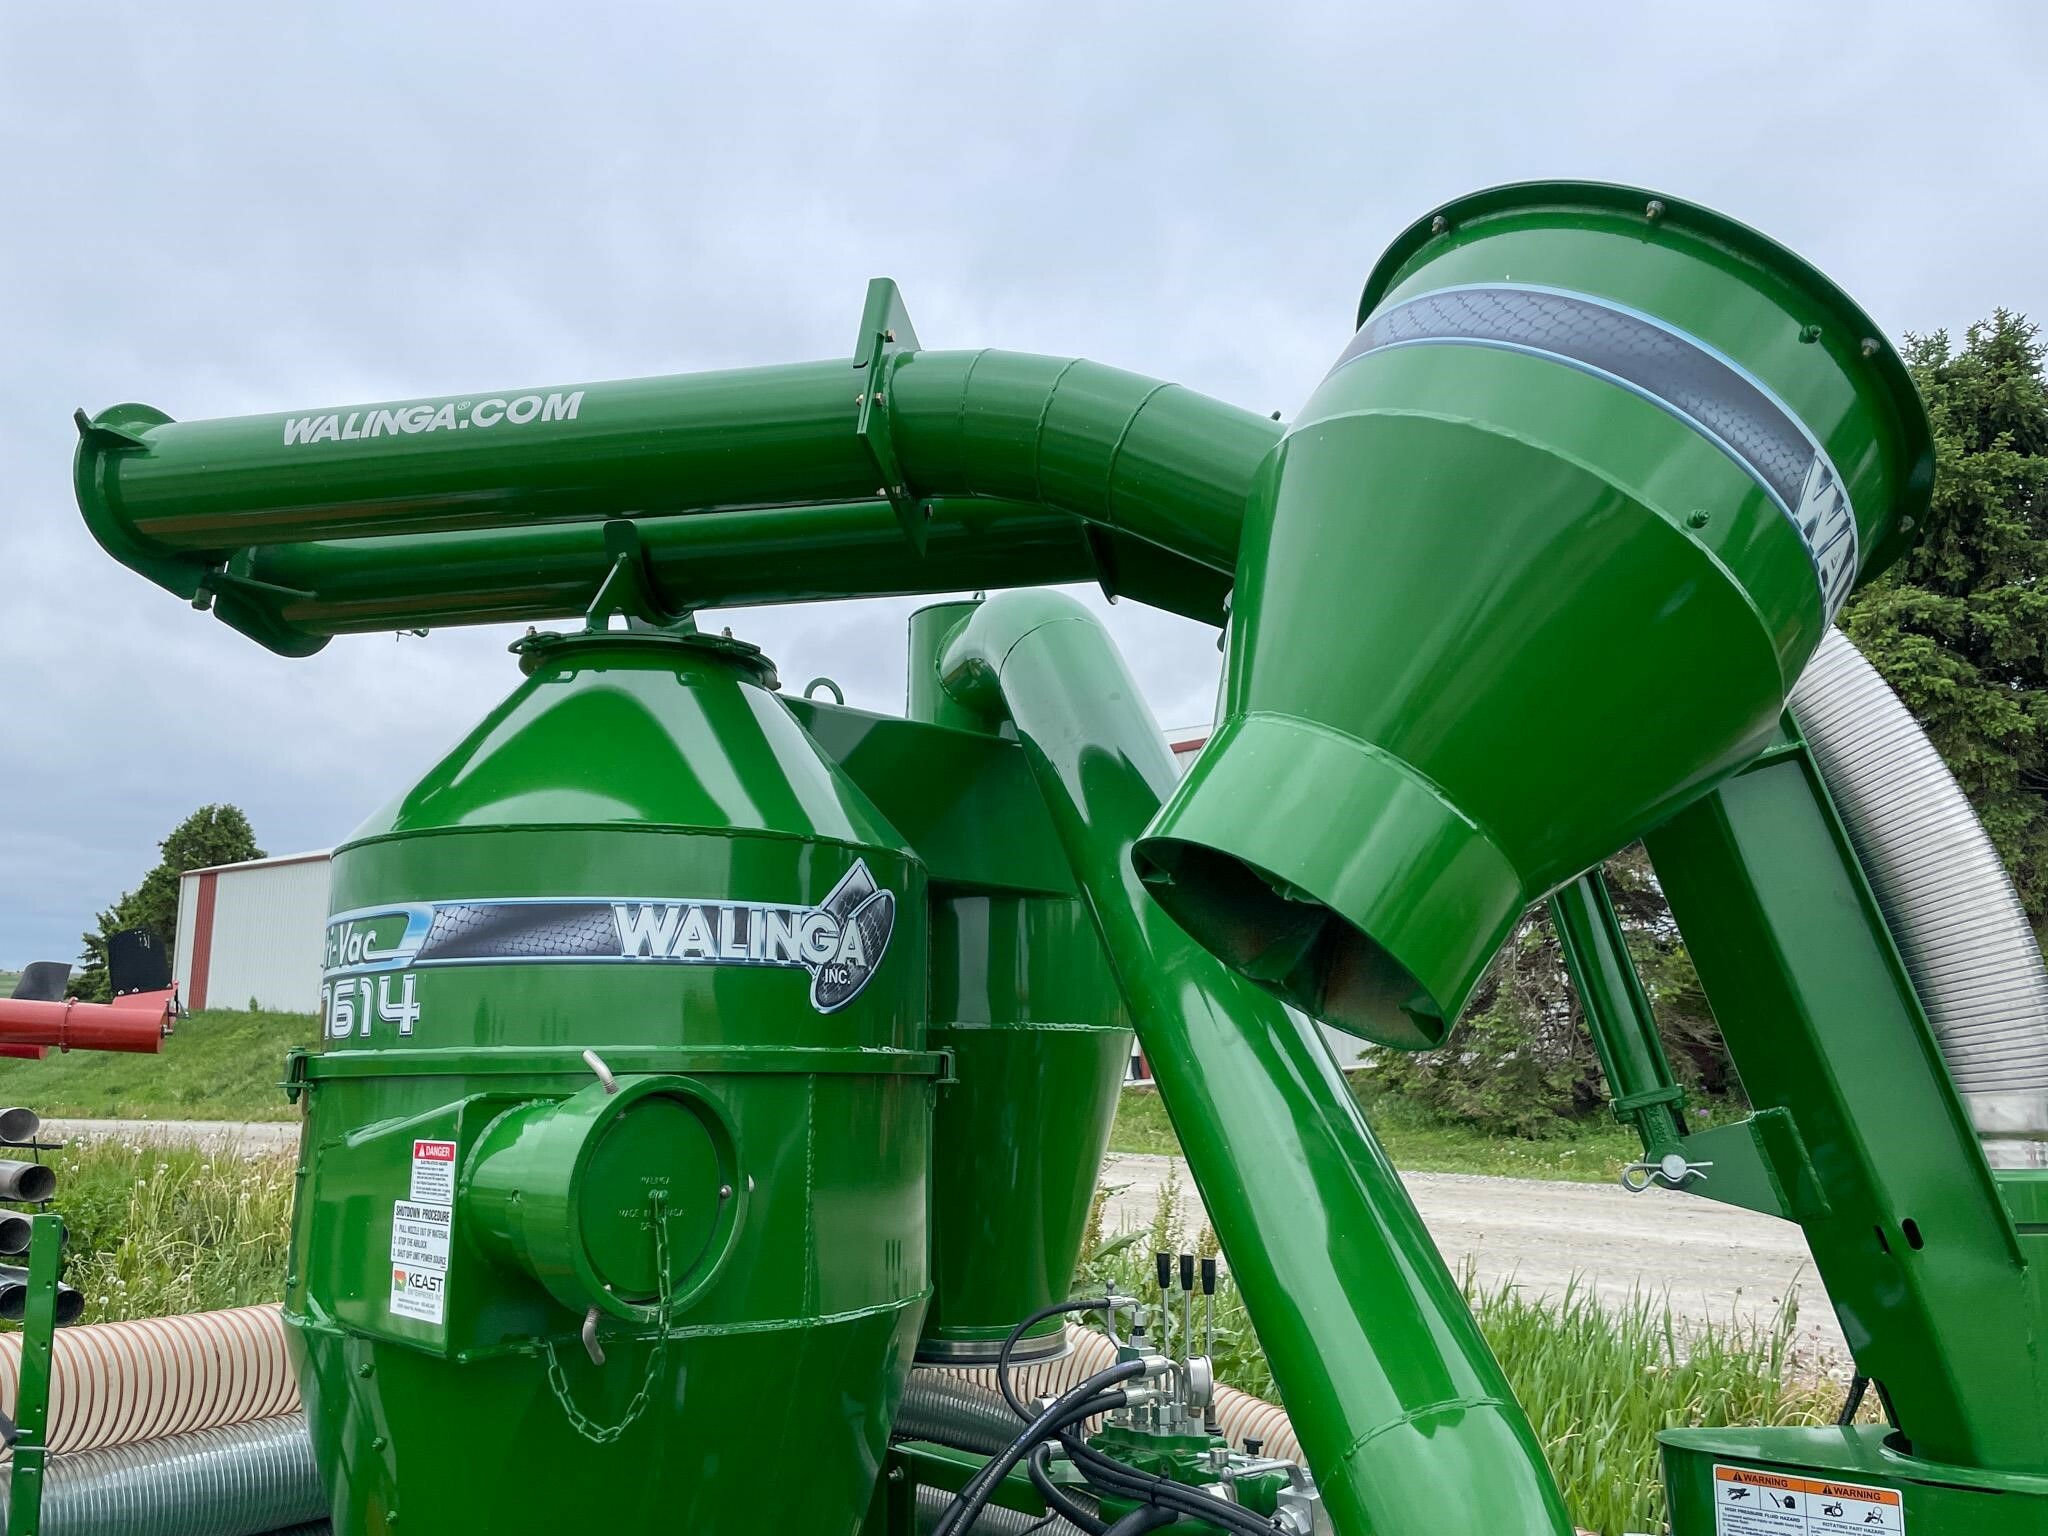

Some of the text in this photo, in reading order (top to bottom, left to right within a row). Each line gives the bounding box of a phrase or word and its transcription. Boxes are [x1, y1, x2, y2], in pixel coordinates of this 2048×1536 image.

[612, 903, 867, 967] WALINGA
[824, 968, 850, 985] INC.
[426, 1145, 450, 1158] DANGER
[396, 1205, 449, 1222] SHUTDOWN PROCEDURE
[409, 1272, 443, 1292] KEAST
[1743, 1473, 1788, 1488] WARNING
[1834, 1487, 1880, 1500] WARNING
[1822, 1522, 1848, 1530] ROTATING
